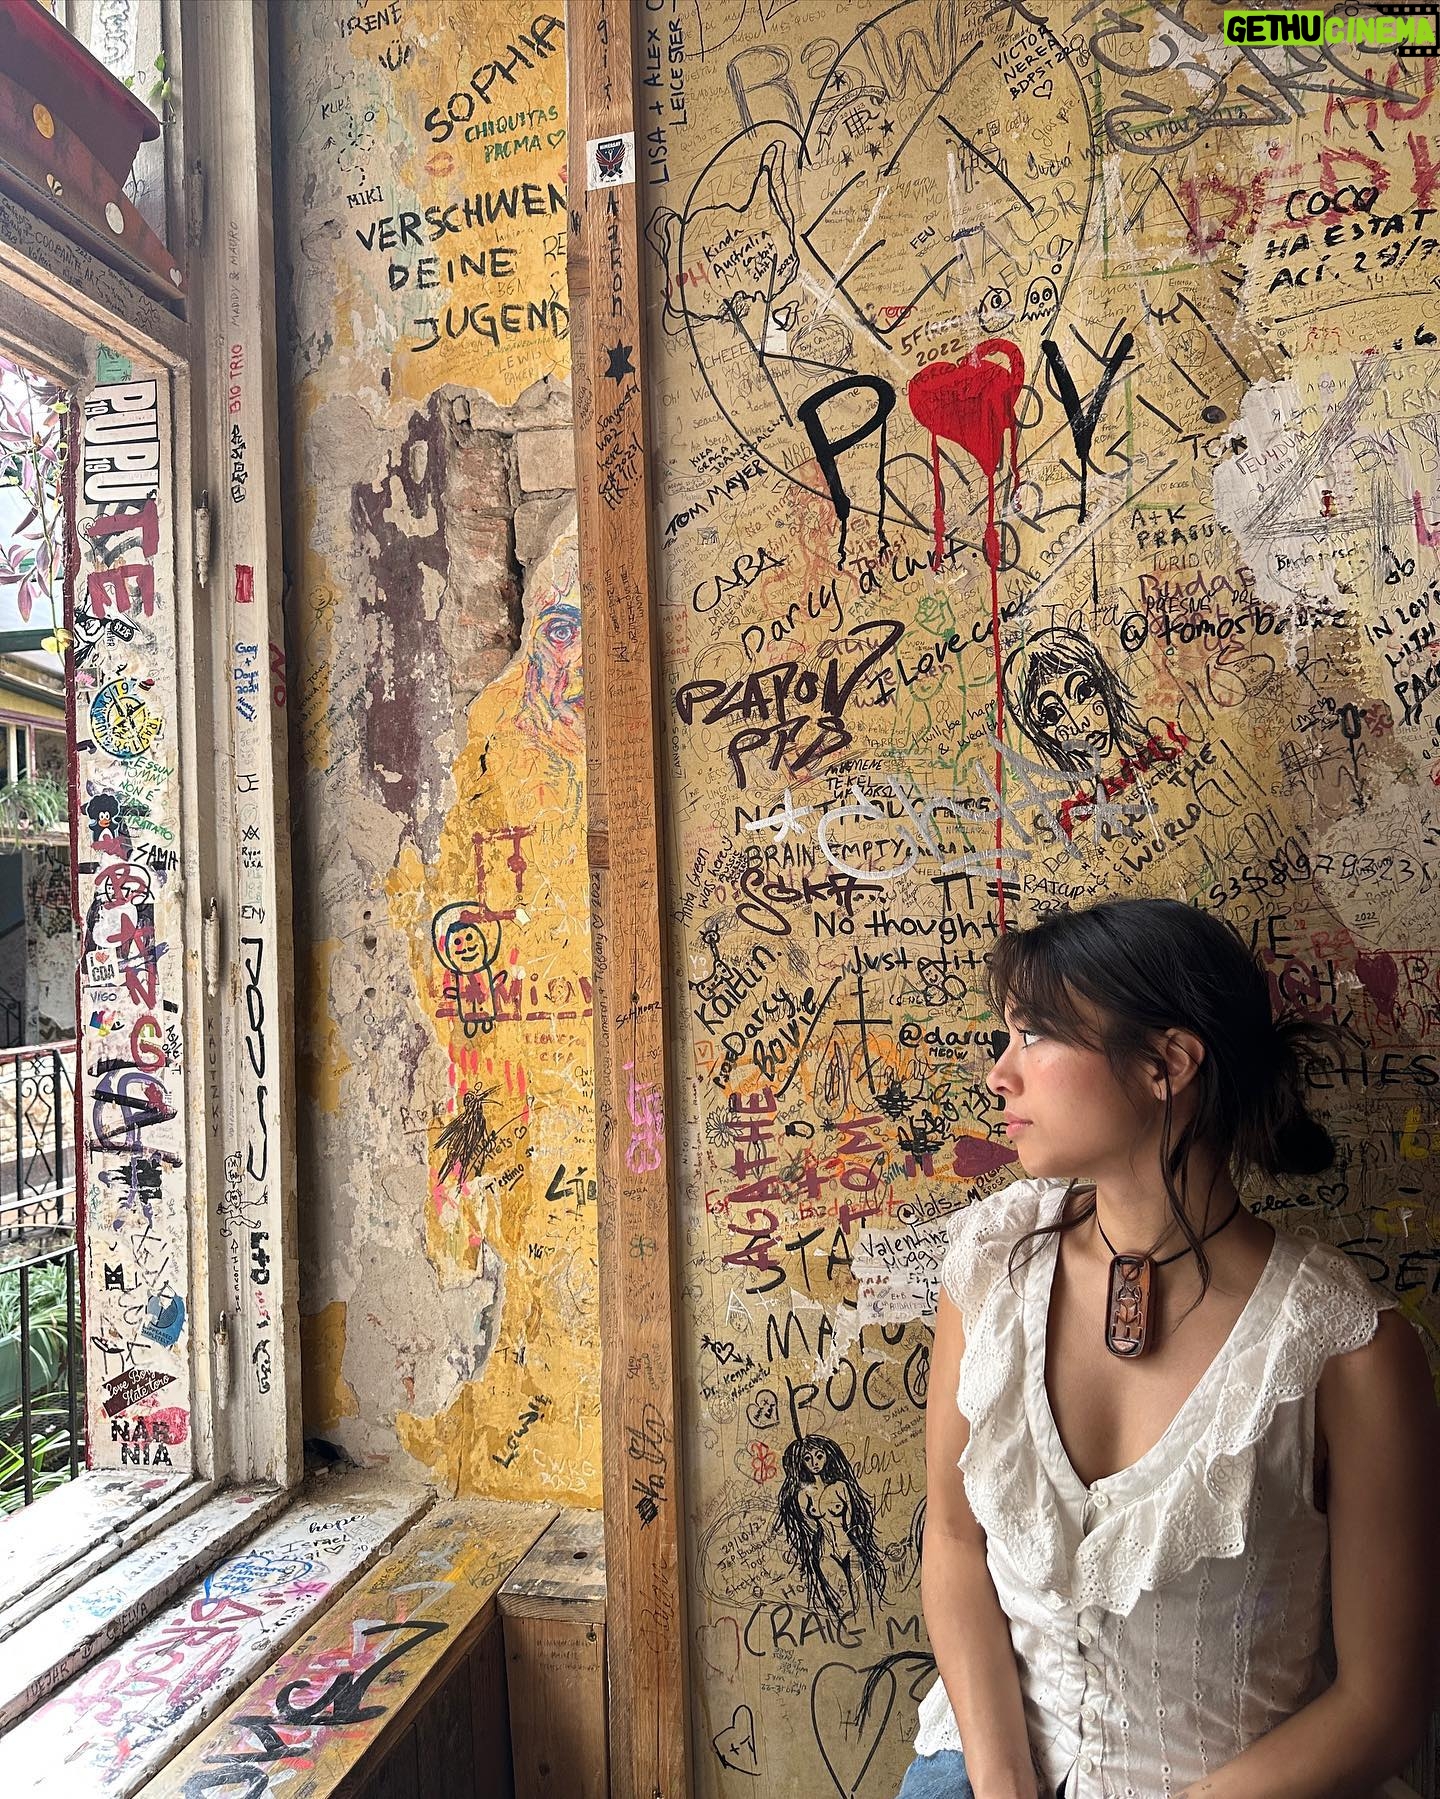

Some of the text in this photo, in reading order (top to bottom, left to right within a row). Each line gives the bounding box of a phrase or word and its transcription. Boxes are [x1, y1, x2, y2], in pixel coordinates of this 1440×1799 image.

[424, 13, 565, 143] SOPHIA
[643, 28, 664, 86] ALEX
[668, 18, 687, 126] LEICESTER
[464, 105, 559, 145] CHIQUITAS
[648, 126, 669, 184] LISA
[346, 186, 384, 208] MIKI
[229, 220, 239, 269] MAURO
[703, 228, 745, 262] Kinda
[713, 231, 772, 279] Australia
[1264, 208, 1438, 261] HA ESTAT
[388, 247, 517, 291] DEINE
[229, 287, 239, 327] MADDY
[411, 298, 569, 352] JUGEND
[229, 343, 243, 382] TRIO
[916, 339, 964, 368] 2022
[229, 385, 241, 415] BIO
[665, 502, 709, 537] TOM
[707, 459, 768, 506] MAYER
[708, 593, 736, 627] DALLA
[746, 843, 818, 870] BRAIN
[816, 911, 856, 938] No
[120, 1442, 173, 1467] NIA
[744, 1602, 867, 1656] CRAIG
